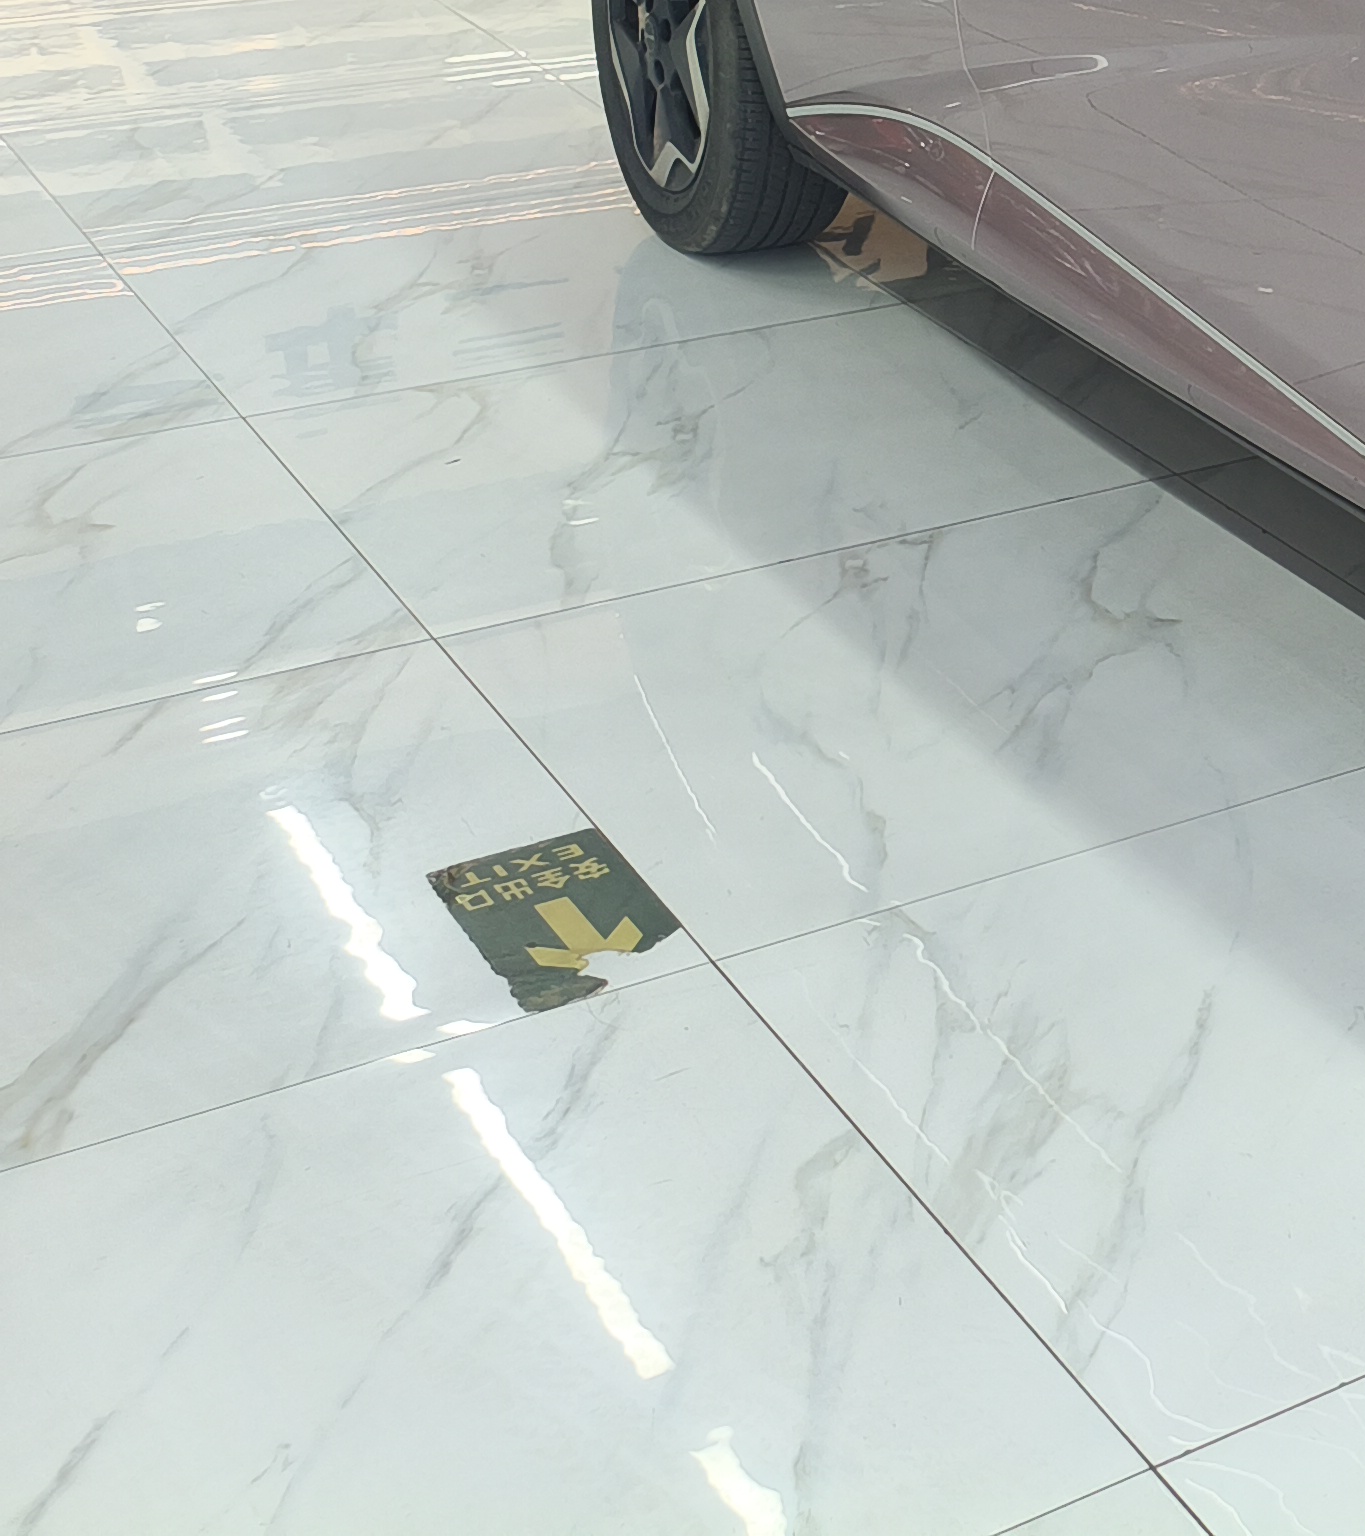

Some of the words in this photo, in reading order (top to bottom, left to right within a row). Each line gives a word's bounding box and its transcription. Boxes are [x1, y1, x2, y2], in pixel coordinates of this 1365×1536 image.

[454, 856, 611, 911] 安全出口
[460, 843, 585, 888] EXIT
